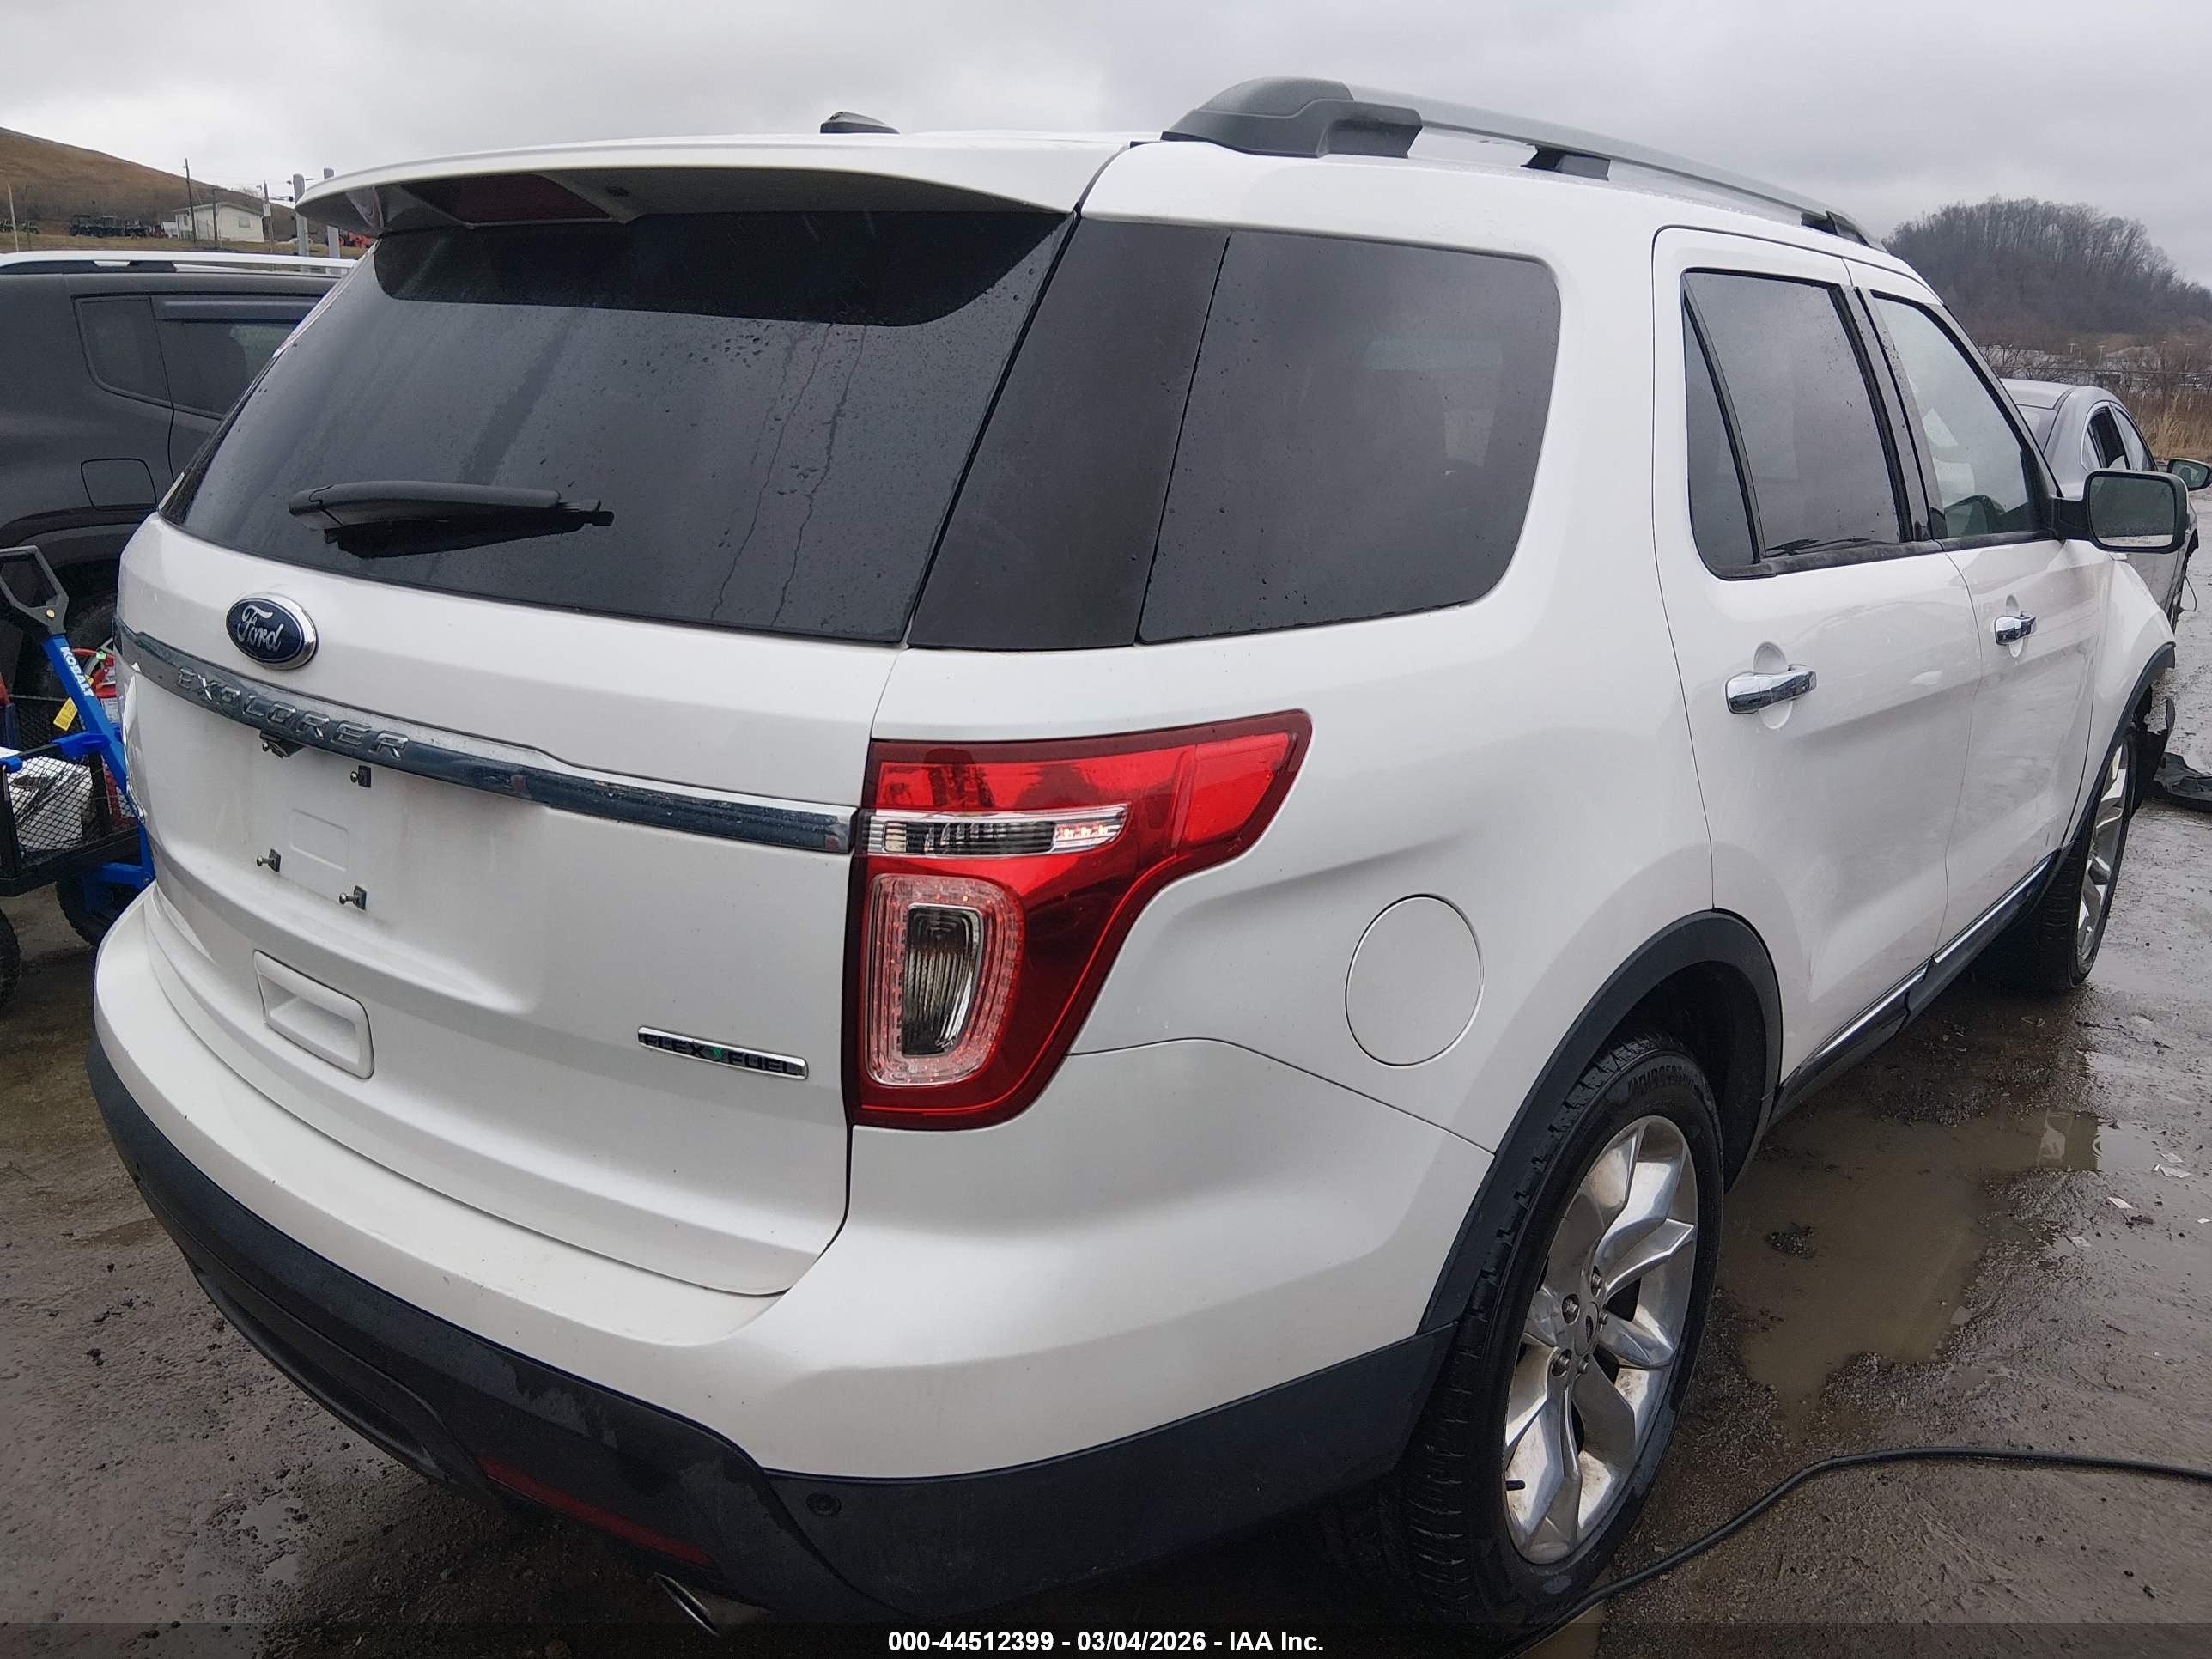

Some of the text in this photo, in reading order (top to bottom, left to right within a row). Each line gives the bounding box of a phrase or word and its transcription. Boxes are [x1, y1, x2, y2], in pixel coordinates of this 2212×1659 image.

[237, 605, 284, 651] Ford
[60, 646, 94, 696] KOBALT
[177, 665, 410, 759] EXPLORER
[642, 1032, 799, 1076] FLEX FUEL
